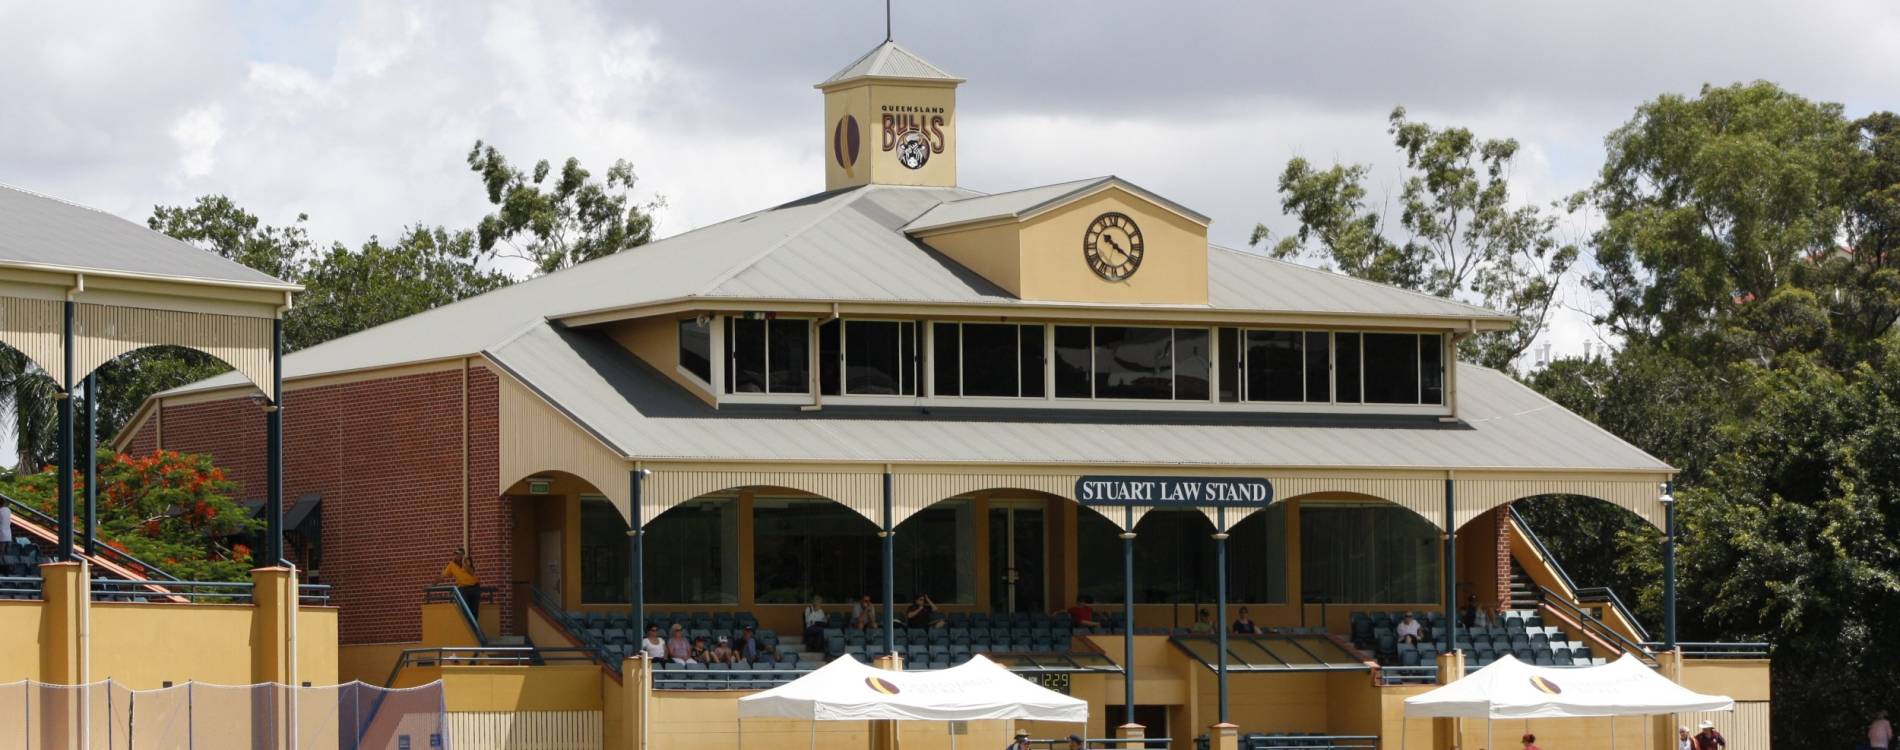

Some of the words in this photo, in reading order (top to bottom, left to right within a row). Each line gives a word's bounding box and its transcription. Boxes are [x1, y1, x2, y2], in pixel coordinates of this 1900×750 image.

[881, 105, 944, 113] QUEENSLAND
[882, 113, 944, 154] BULLS
[1082, 481, 1155, 500] STUART
[1159, 482, 1201, 501] LAW
[1205, 483, 1266, 502] STAND
